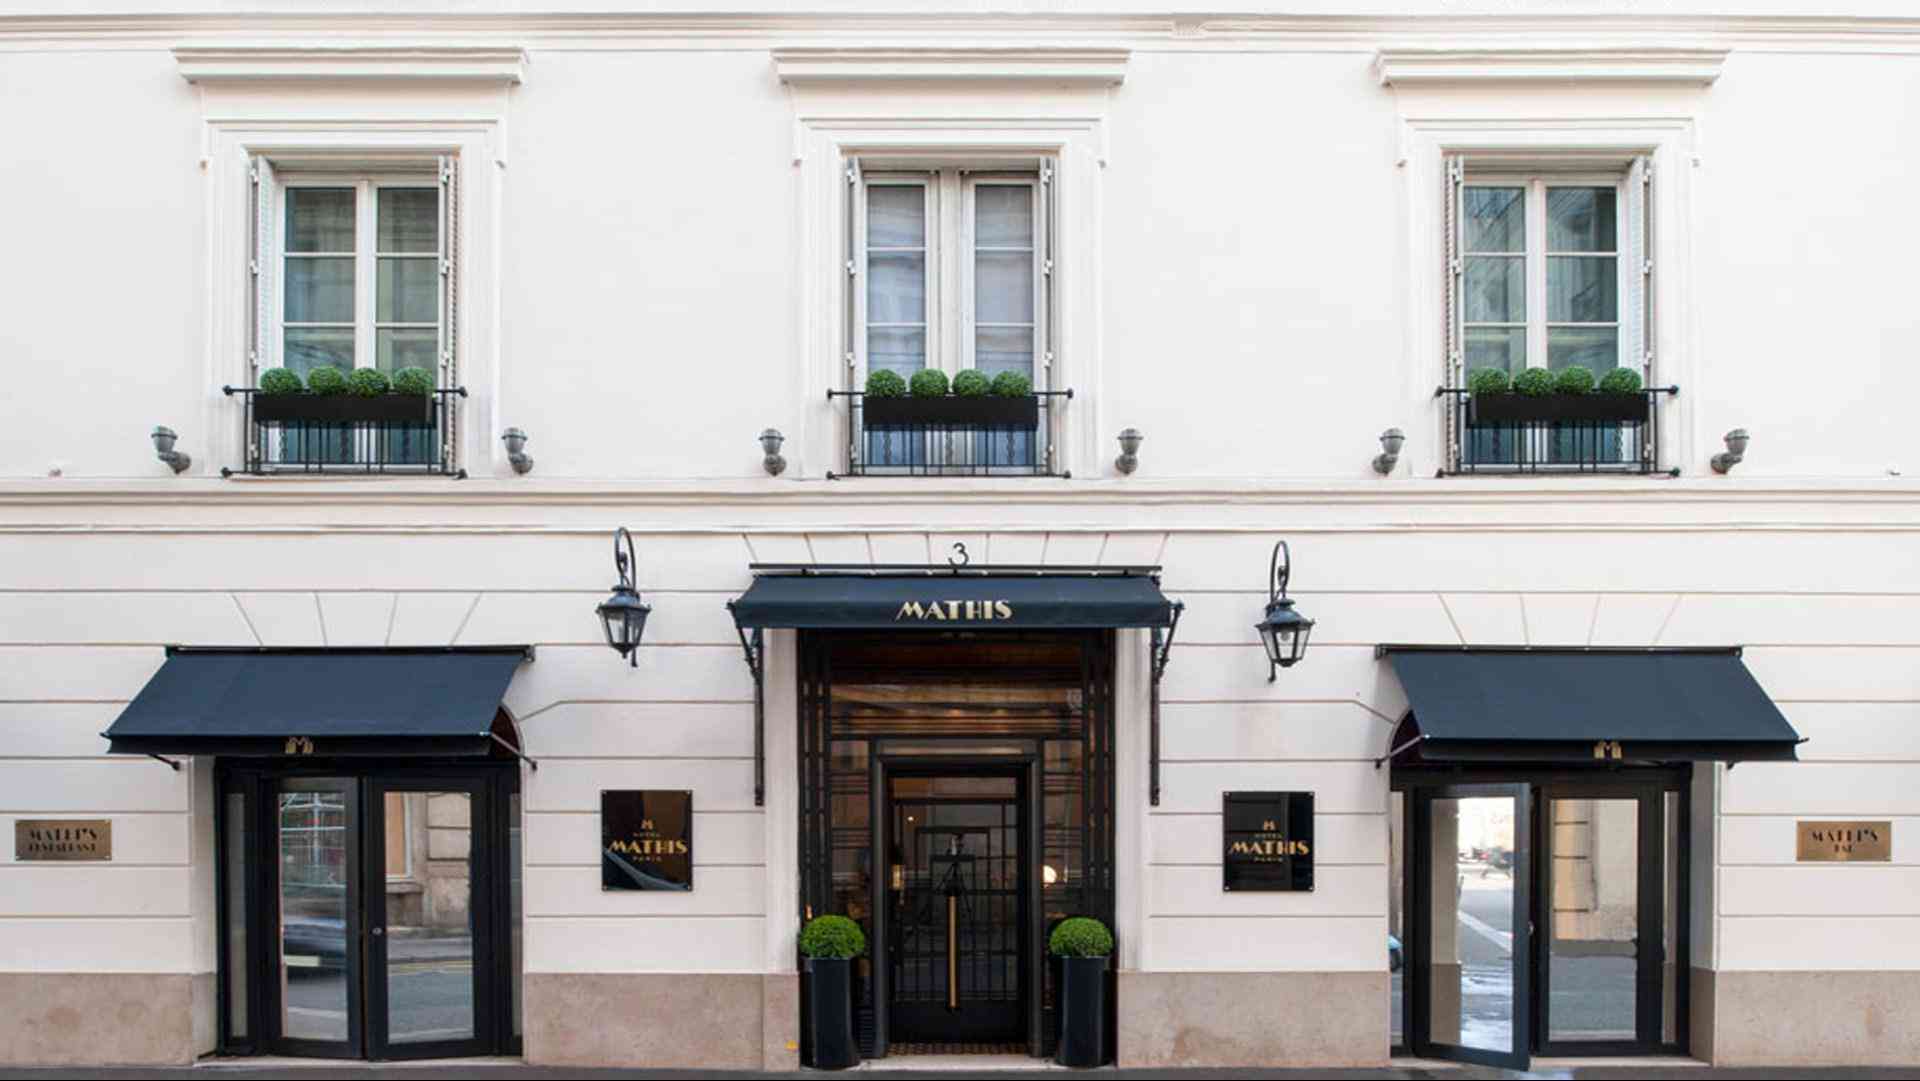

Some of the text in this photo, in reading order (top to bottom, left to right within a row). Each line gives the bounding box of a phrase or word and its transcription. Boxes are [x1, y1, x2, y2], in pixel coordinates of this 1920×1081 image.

[947, 541, 969, 569] 3
[895, 600, 1013, 620] MATHIS
[607, 840, 688, 854] MATHIS
[1230, 841, 1310, 855] MATHIS
